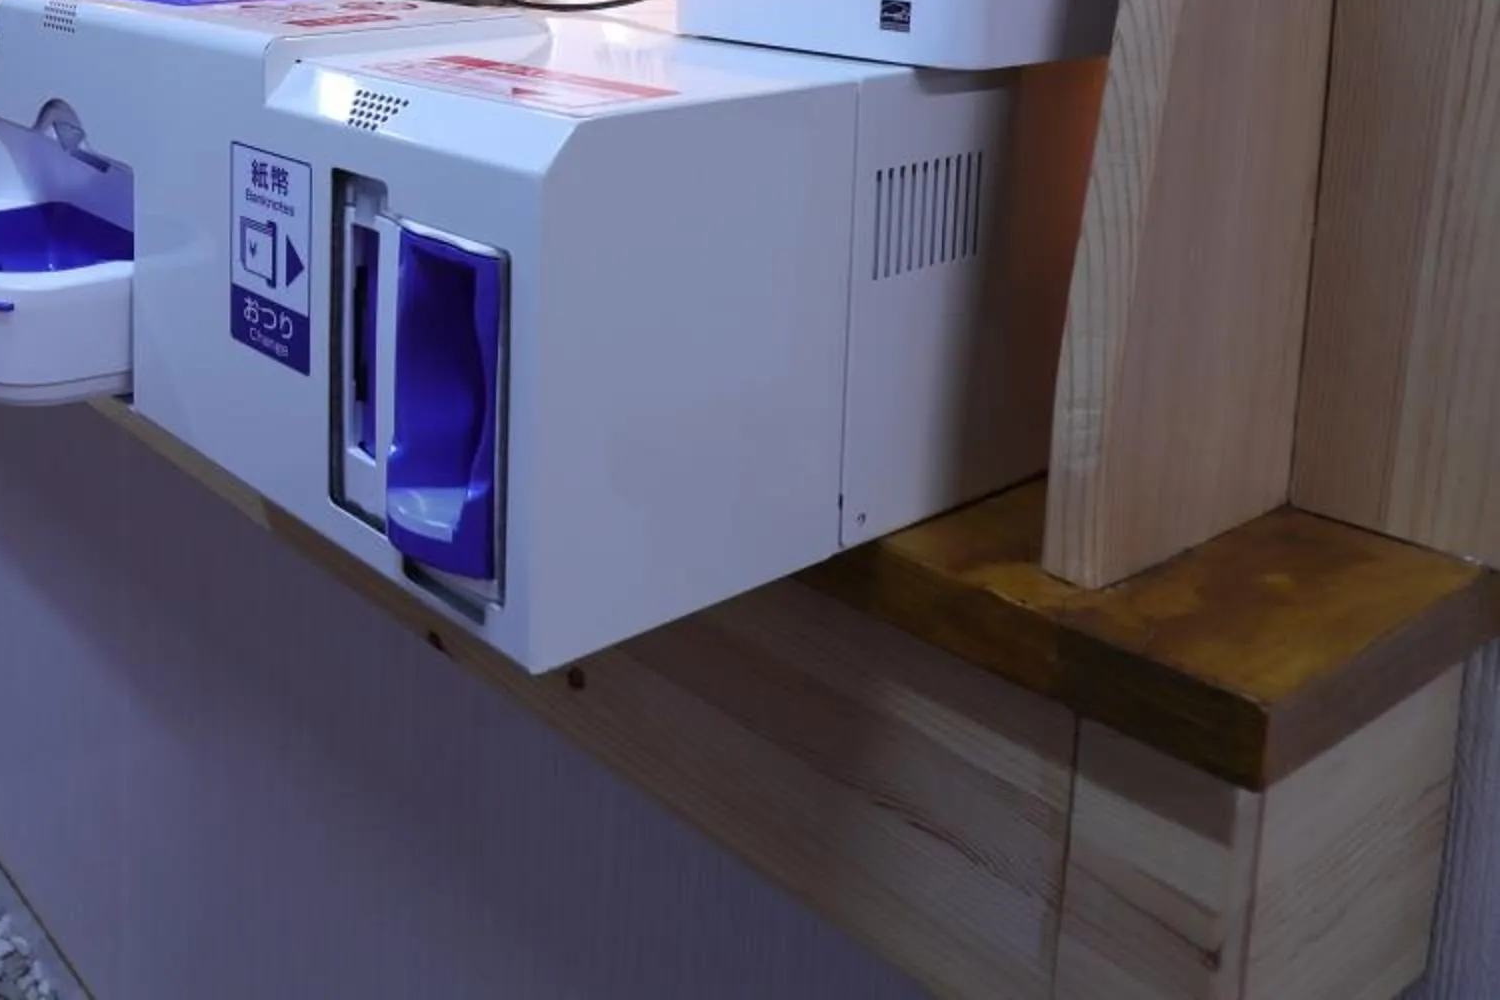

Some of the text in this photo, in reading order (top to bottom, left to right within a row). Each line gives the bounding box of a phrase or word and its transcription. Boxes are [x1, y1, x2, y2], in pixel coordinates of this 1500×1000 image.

[251, 159, 289, 197] 紙幣
[245, 187, 295, 217] Banknotes
[243, 297, 294, 340] おつり
